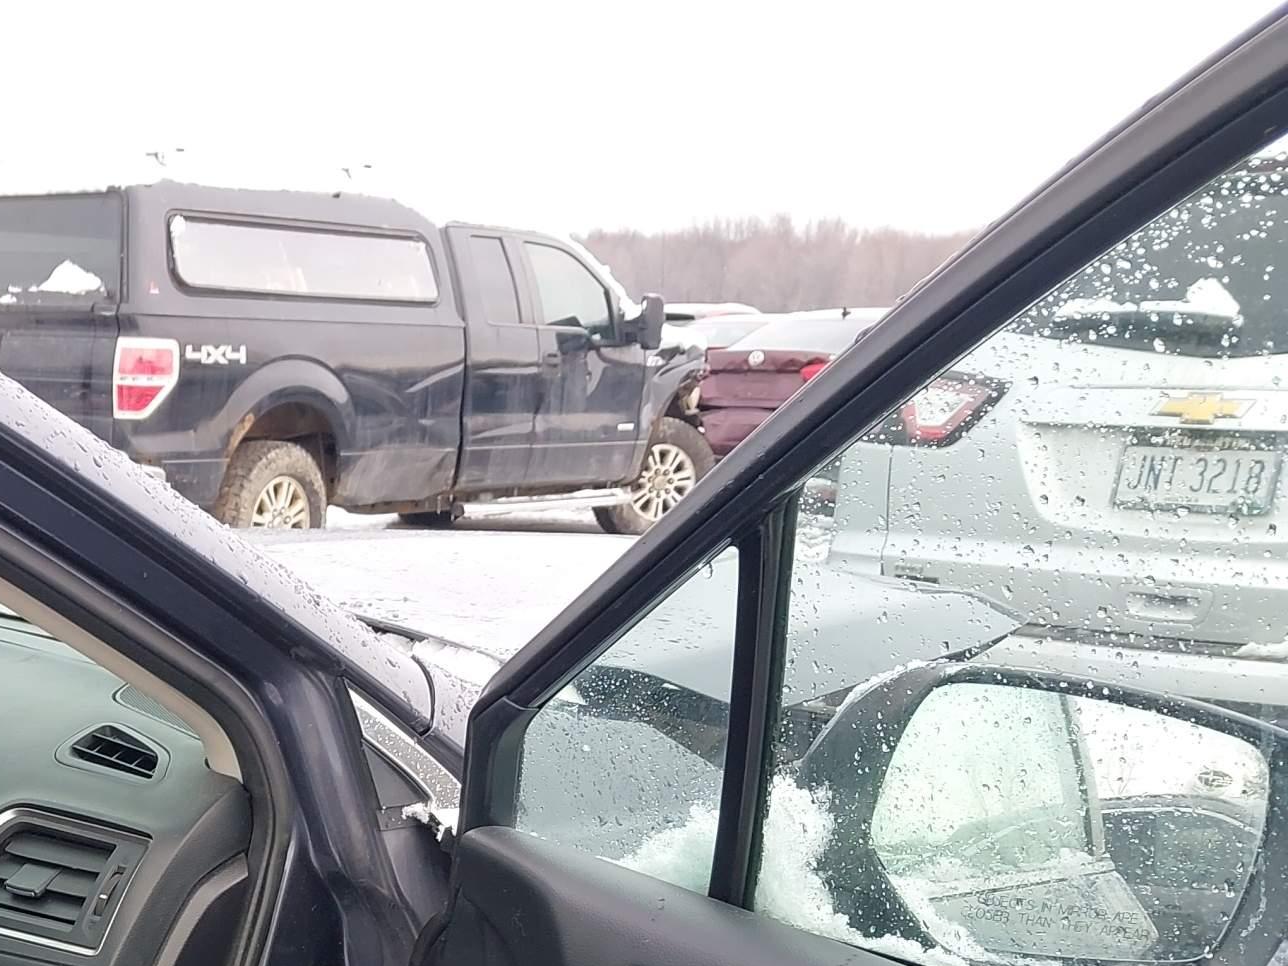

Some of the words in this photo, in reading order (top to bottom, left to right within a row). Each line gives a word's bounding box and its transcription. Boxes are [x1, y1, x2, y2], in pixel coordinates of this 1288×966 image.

[1189, 457, 1265, 494] 3218
[1018, 912, 1051, 928] THAN
[1112, 911, 1139, 925] ARE
